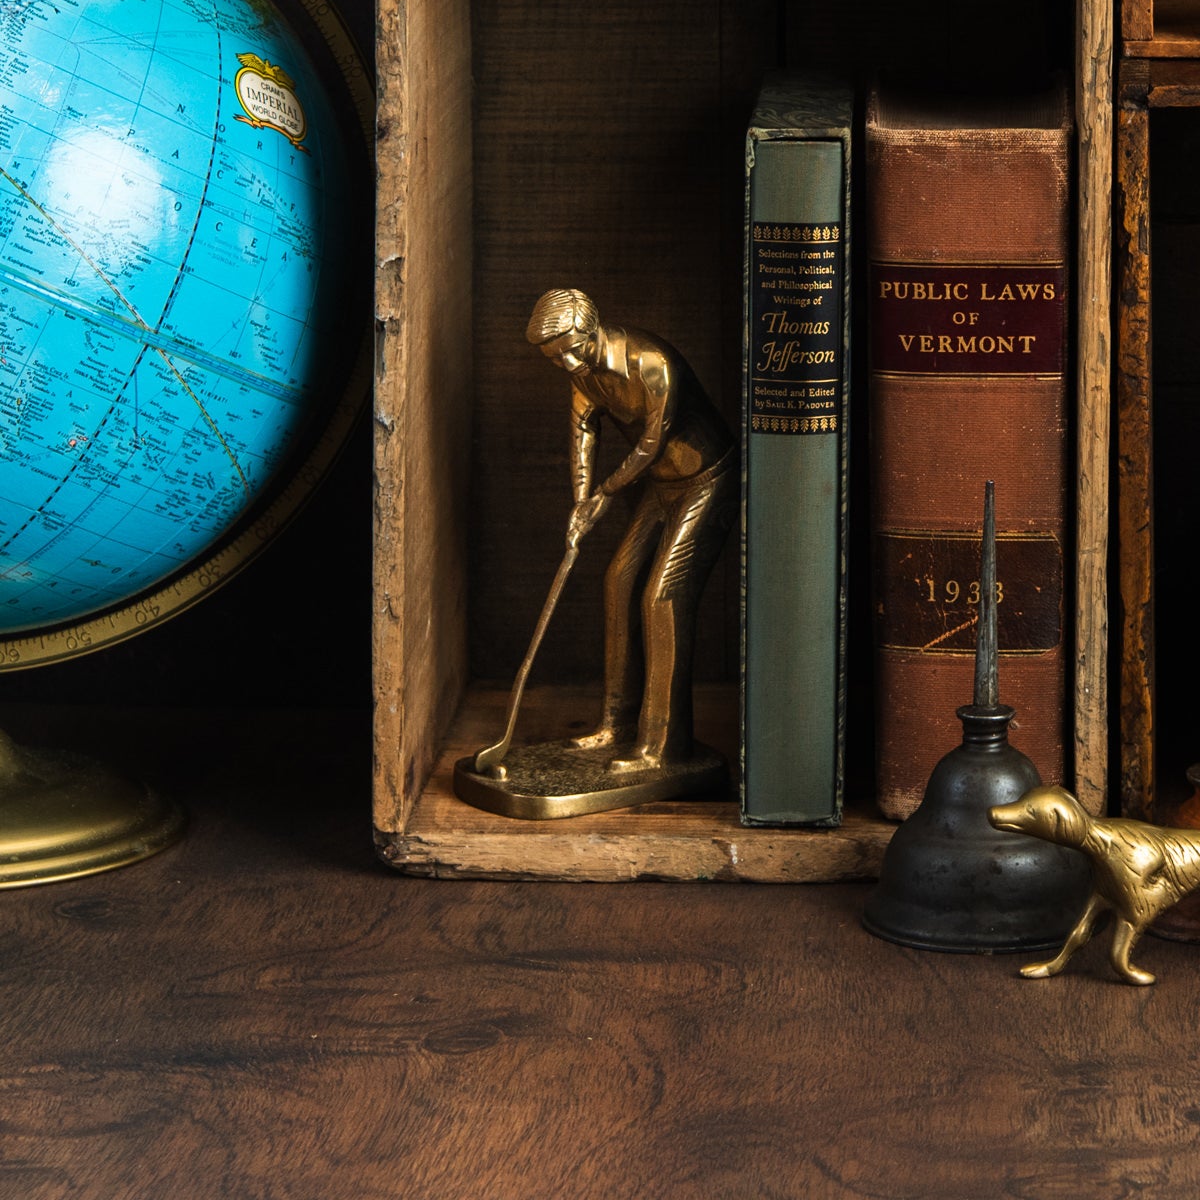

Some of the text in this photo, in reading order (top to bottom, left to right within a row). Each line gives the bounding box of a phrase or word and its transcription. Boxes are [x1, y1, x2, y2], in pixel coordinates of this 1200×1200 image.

[260, 81, 286, 100] CRAM'S
[246, 86, 300, 122] IMPERIAL
[251, 103, 277, 120] WORLD
[758, 248, 835, 259] Selections from the
[758, 263, 835, 275] Personal, Political,
[761, 279, 833, 292] and Philosophical
[878, 281, 1056, 301] PUBLIC LAWS
[773, 295, 823, 308] Writings of
[761, 310, 831, 335] Thomas
[952, 312, 979, 326] OF
[898, 334, 1036, 354] VERMONT
[756, 340, 835, 373] Jefferson
[754, 386, 835, 397] Selected and Edited
[754, 399, 764, 409] by
[135, 605, 161, 625] 40
[66, 631, 92, 650] 50
